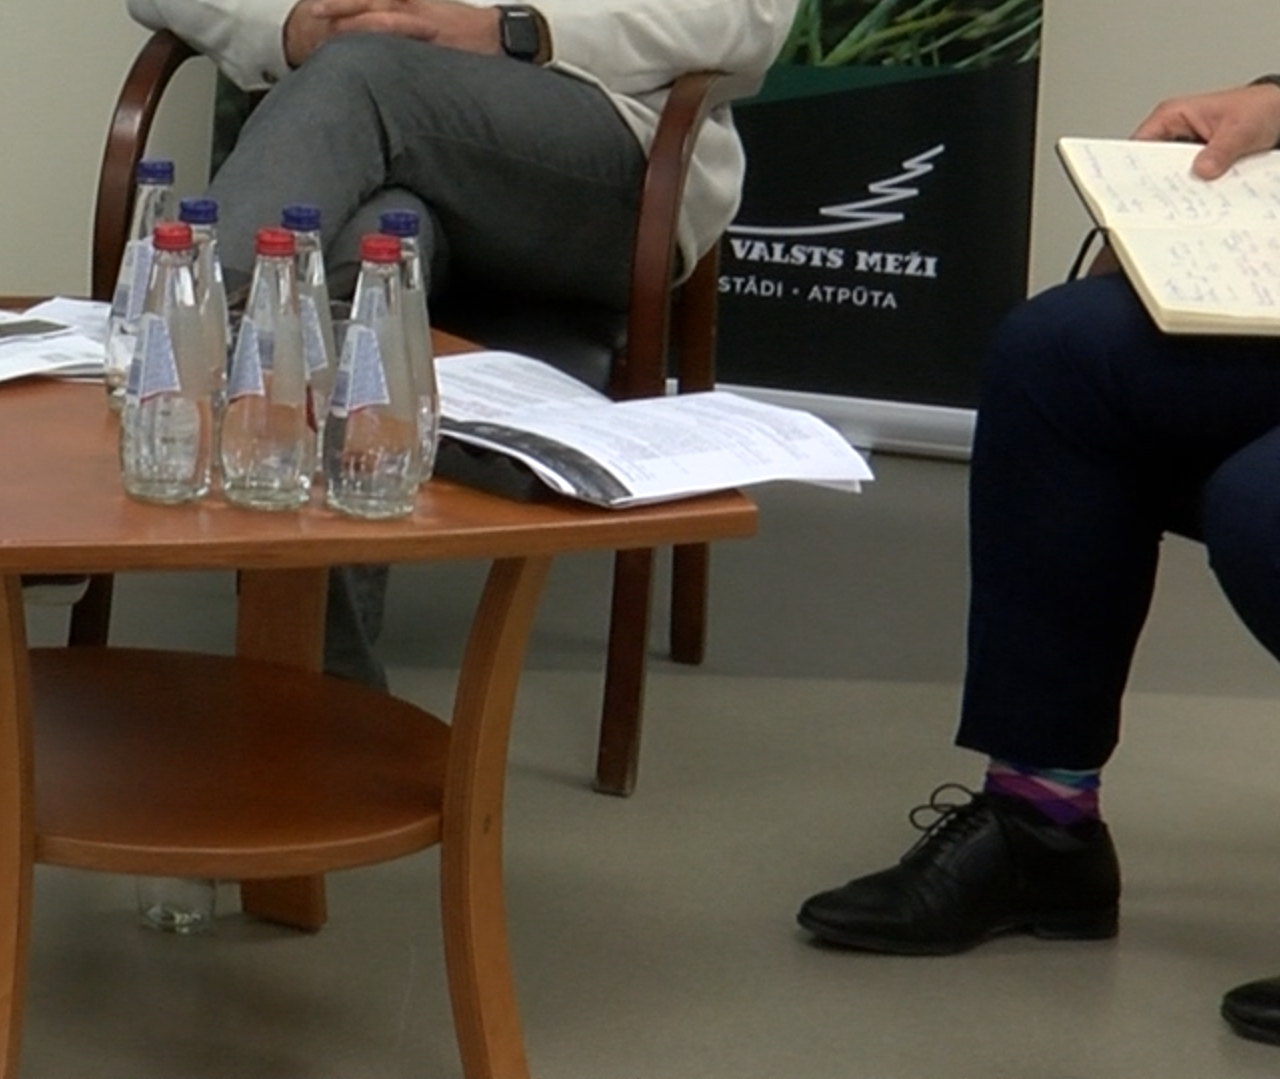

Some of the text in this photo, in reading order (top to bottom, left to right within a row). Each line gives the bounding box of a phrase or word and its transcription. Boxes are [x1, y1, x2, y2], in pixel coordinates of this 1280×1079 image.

[730, 238, 938, 278] VALSTS MEŽI
[718, 274, 897, 309] STĀDI ATPŪTA
